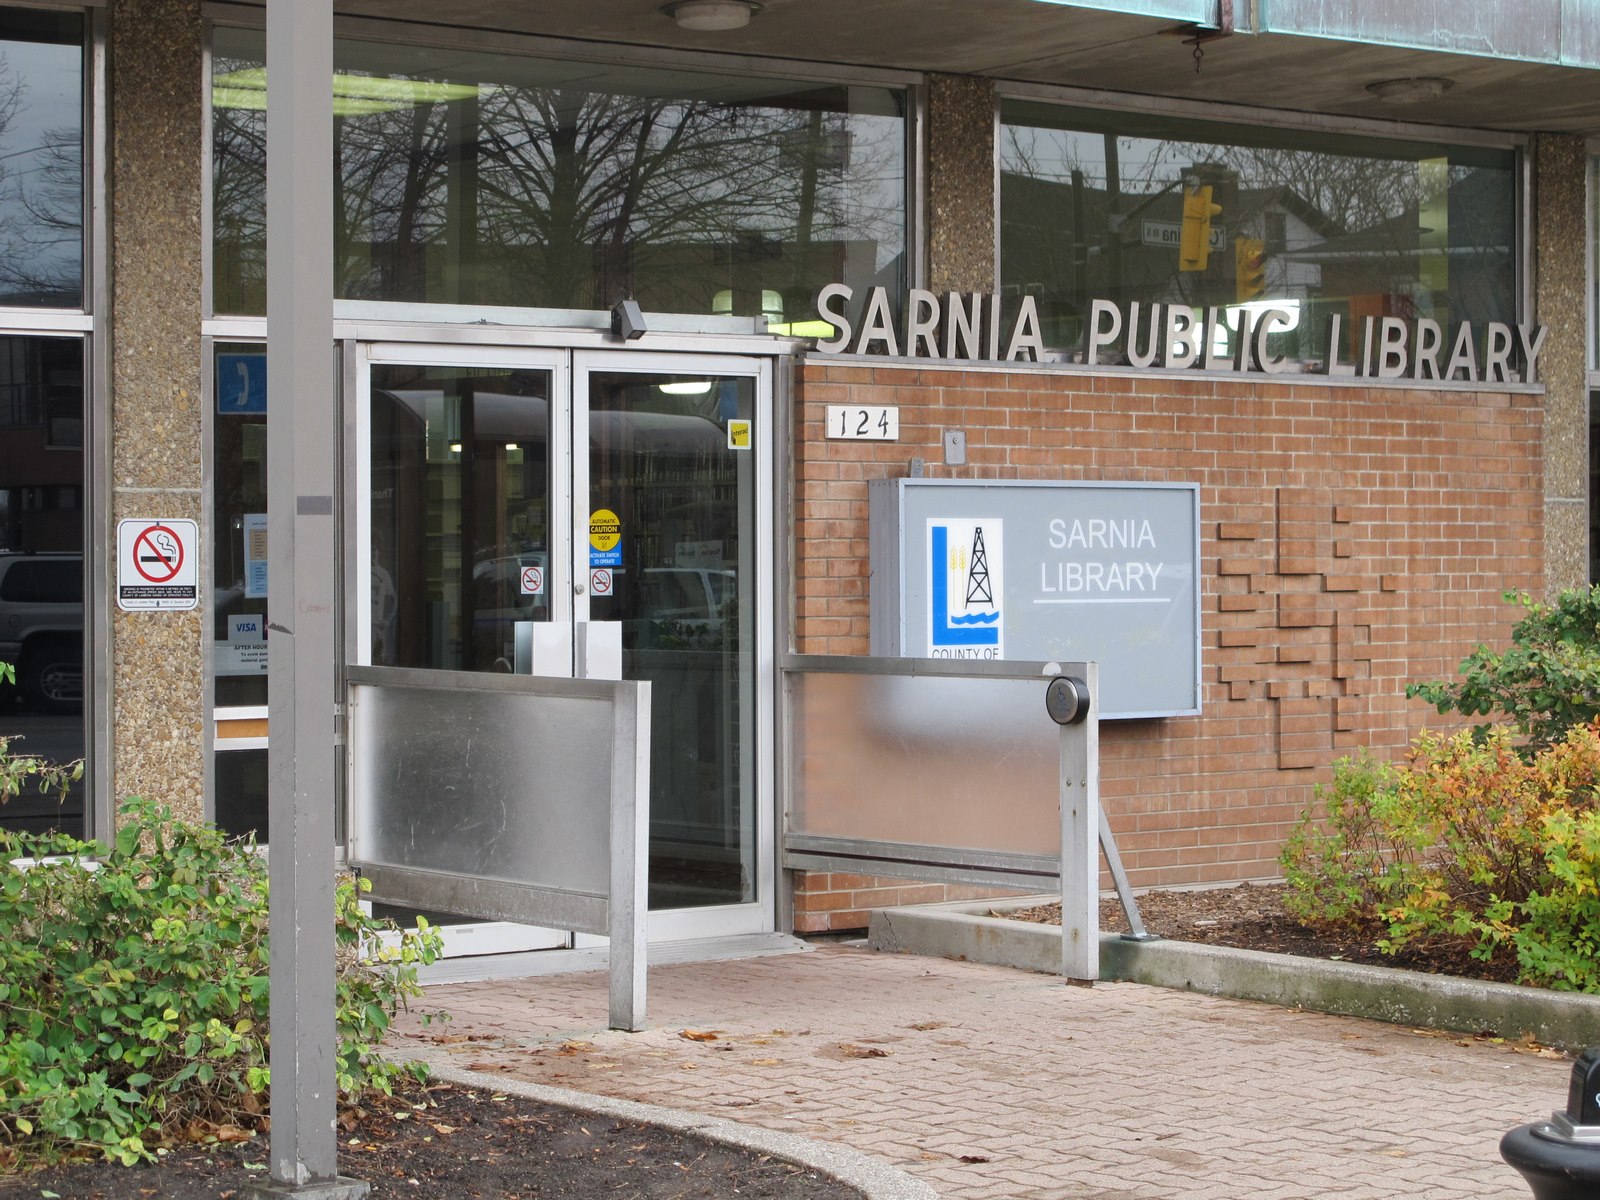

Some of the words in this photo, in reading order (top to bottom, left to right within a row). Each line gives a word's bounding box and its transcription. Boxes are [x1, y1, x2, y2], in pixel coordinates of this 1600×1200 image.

[815, 282, 1045, 363] SARNIA
[1086, 298, 1291, 374] PUBLIC
[1326, 313, 1549, 384] LIBRARY
[841, 409, 889, 438] 124
[1048, 518, 1156, 549] SARNIA
[1041, 562, 1164, 592] LIBRARY
[236, 623, 256, 632] VISA
[932, 648, 980, 659] COUNTY
[984, 648, 999, 660] OF
